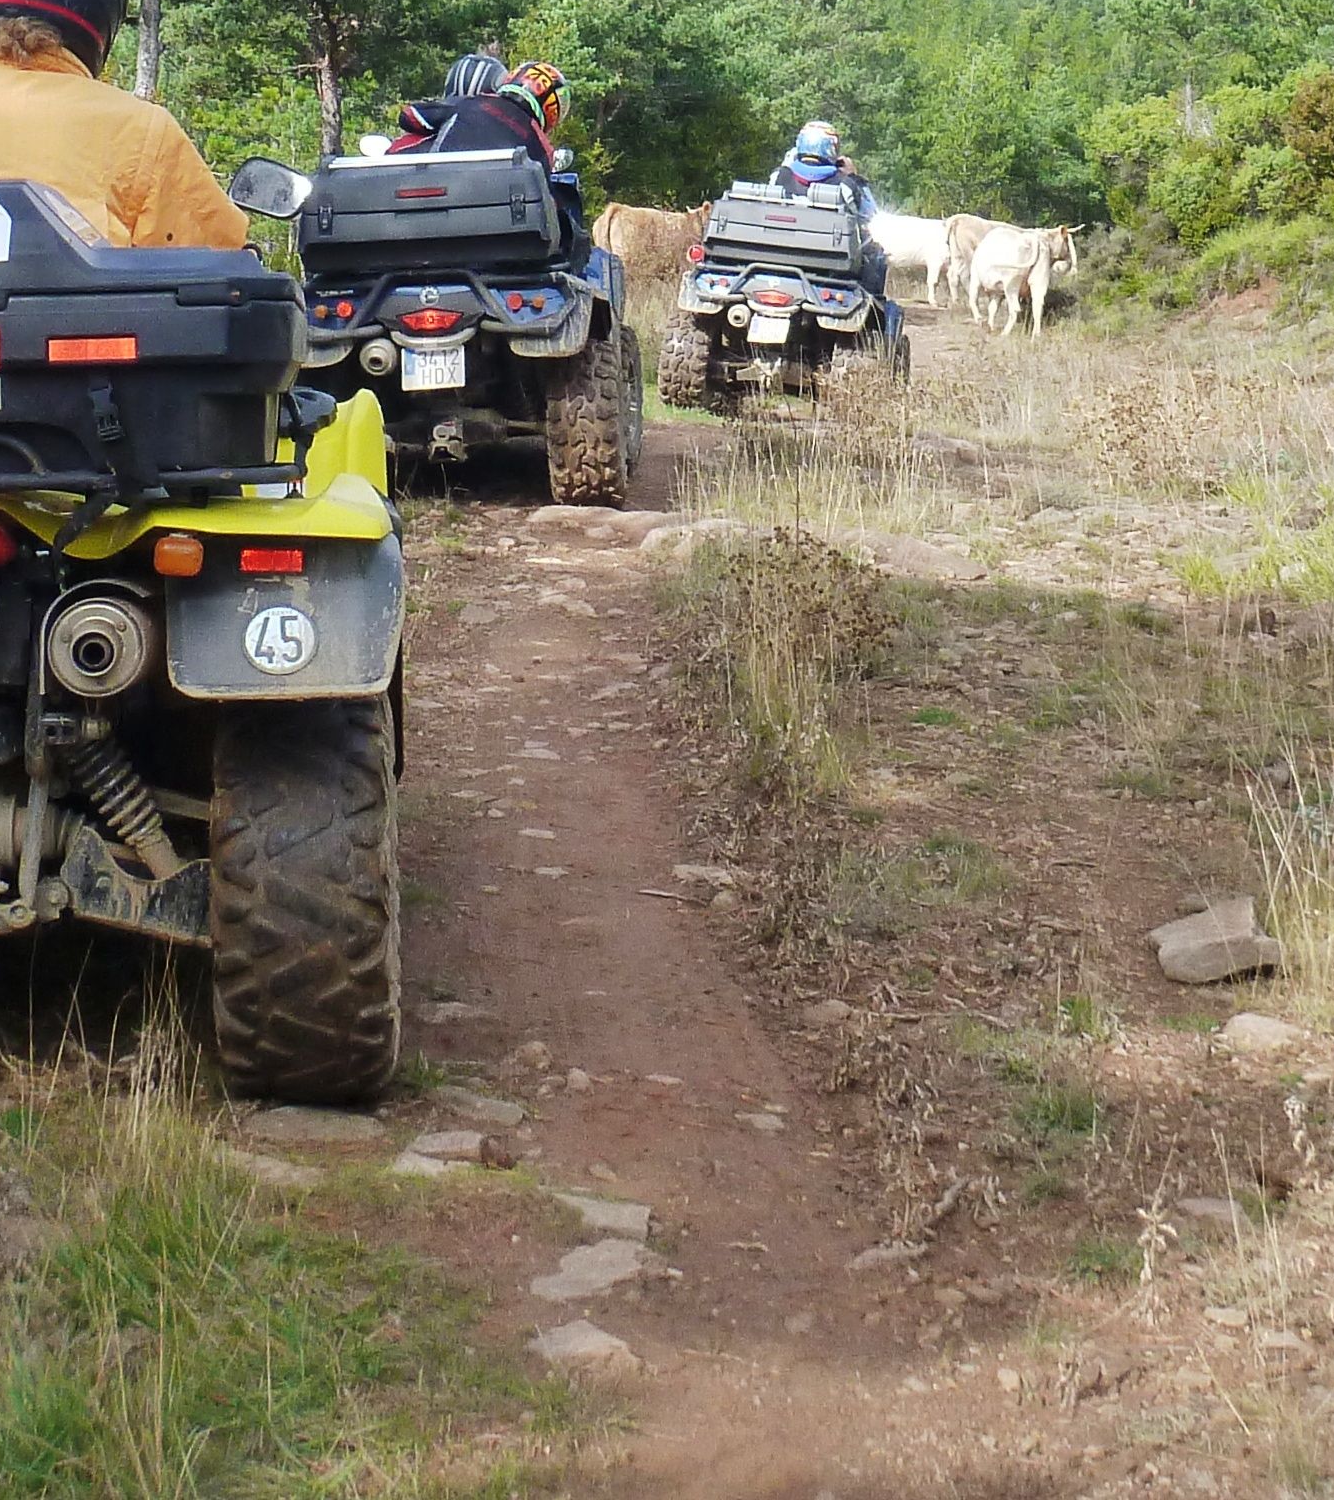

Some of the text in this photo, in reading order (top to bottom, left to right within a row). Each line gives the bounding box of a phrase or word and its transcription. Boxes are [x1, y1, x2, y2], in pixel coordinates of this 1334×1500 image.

[417, 348, 460, 368] 3412
[422, 367, 457, 386] HDX
[255, 615, 303, 664] 45
